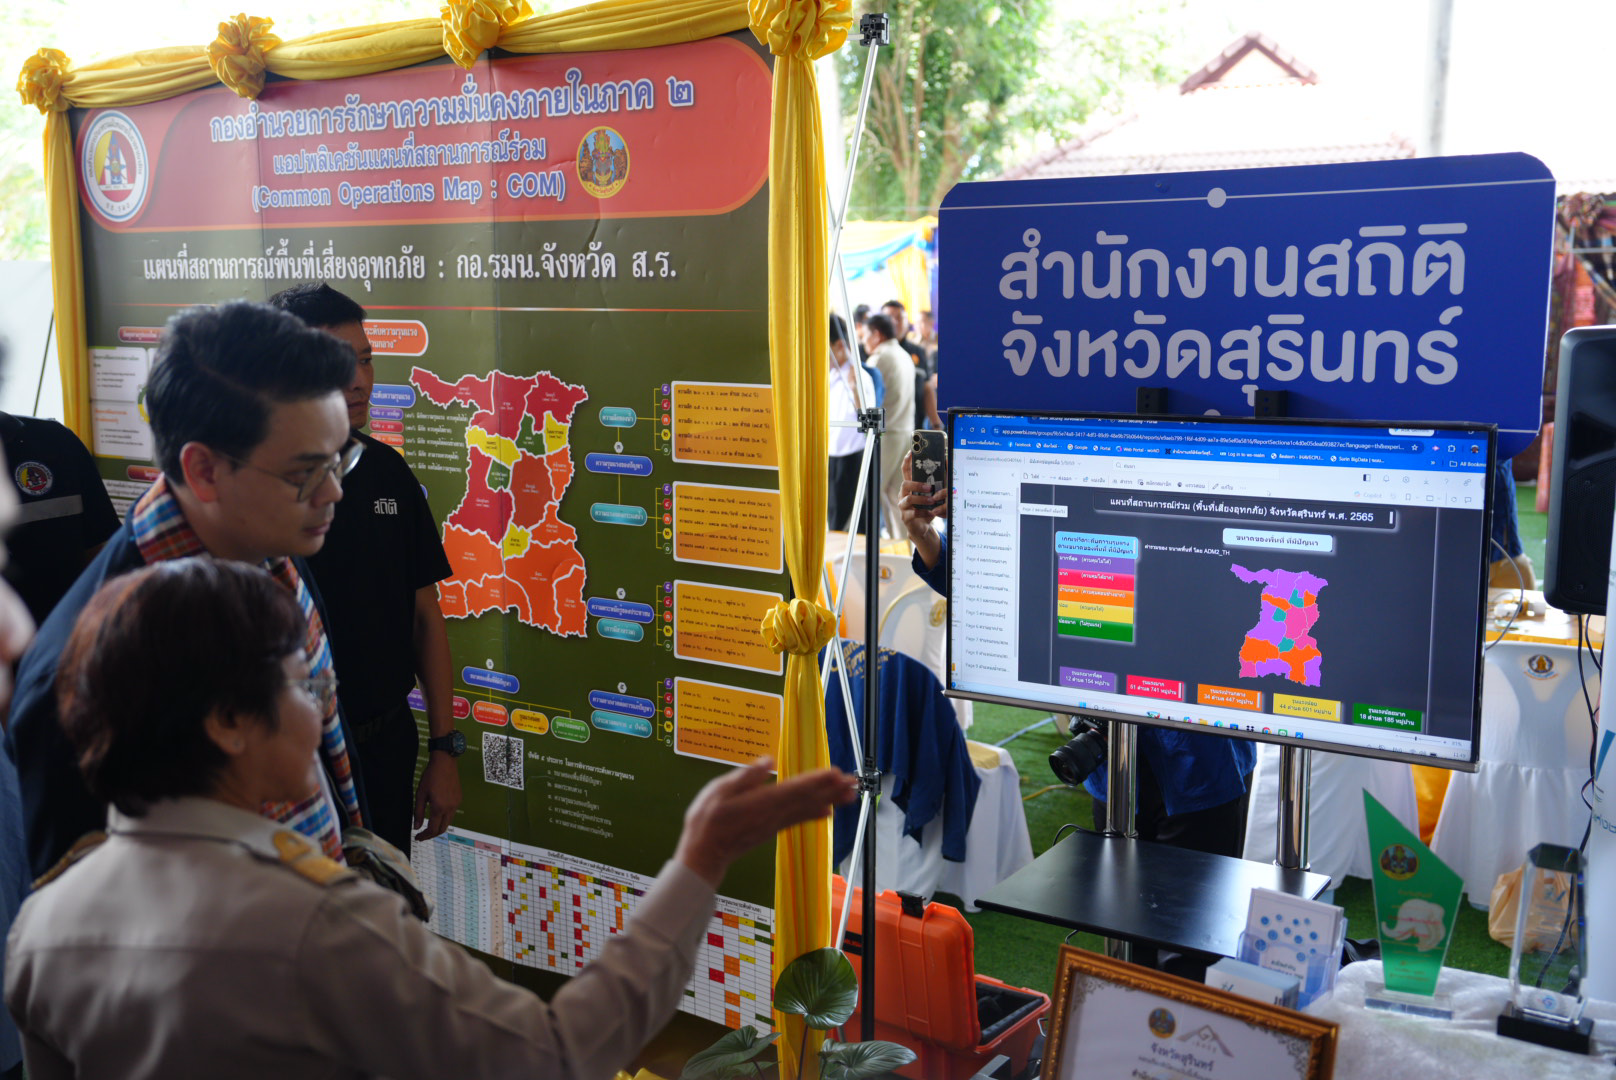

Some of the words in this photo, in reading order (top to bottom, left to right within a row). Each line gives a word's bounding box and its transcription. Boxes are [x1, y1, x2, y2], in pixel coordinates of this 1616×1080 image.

[210, 67, 653, 143] กองอำนวยการรักษาความมั่นคงภายในภาค
[666, 75, 694, 107] ๒
[273, 128, 546, 175] แอปพลิเคชันแผนที่สถานการณ์ร่วม
[252, 186, 331, 212] (Common
[338, 179, 434, 208] Operations
[443, 176, 482, 204] Map
[507, 171, 566, 201] COM)
[143, 238, 425, 292] แผนที่สถานการณ์พื้นที่เสี่ยงอุทกภัย
[457, 241, 616, 279] กอ.รมน.จังหวัด
[632, 250, 677, 278] ส.ร.
[999, 222, 1468, 299] สำนักงานสถิติ
[1001, 306, 1464, 407] จังหวัดสุรินทร์
[374, 498, 398, 514] สถิติ
[1270, 505, 1326, 520] จังหวัดสุรินทร์
[1350, 512, 1374, 522] 2565
[1204, 548, 1230, 556] ADM2_TH
